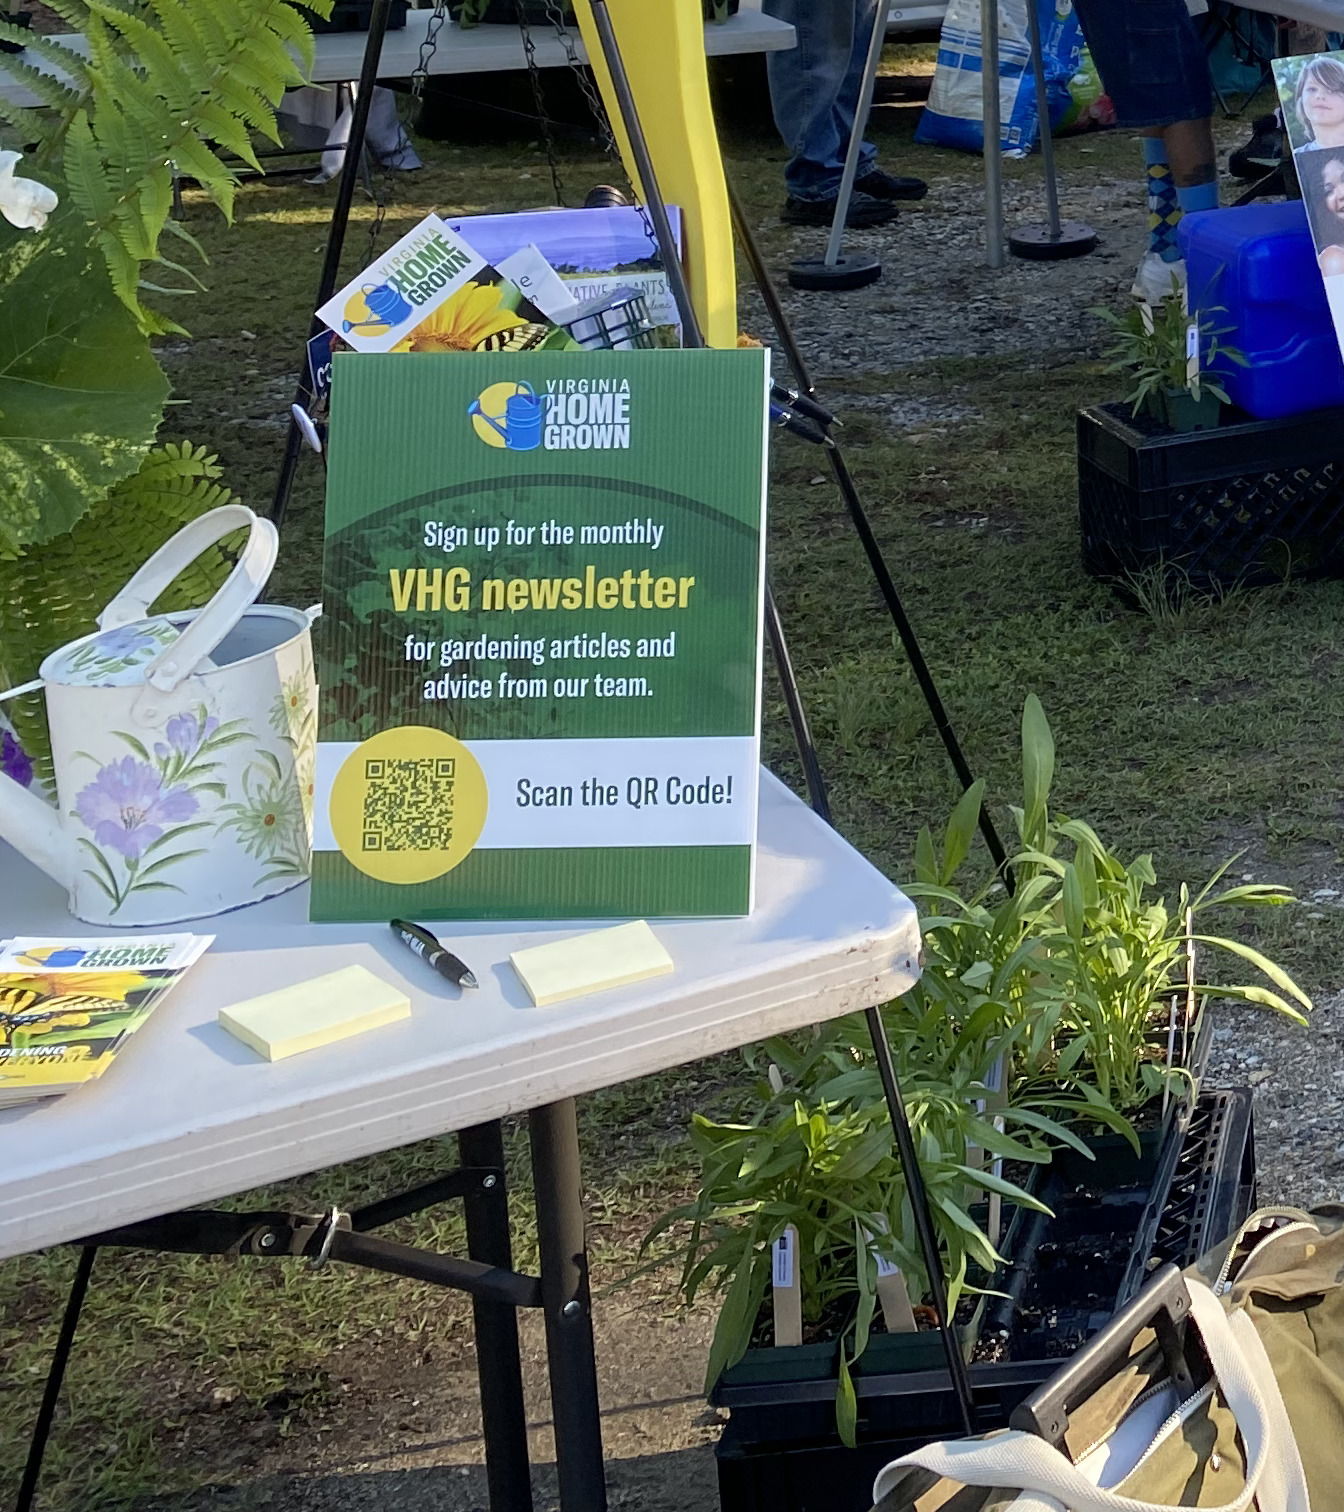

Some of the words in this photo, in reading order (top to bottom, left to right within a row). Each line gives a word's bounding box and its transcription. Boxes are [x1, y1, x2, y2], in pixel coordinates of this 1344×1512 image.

[378, 227, 439, 276] VIRGINIA
[393, 233, 459, 294] HOME
[406, 248, 472, 307] GROWN
[545, 378, 631, 393] VIRGINIA
[548, 393, 631, 424] HOME
[544, 424, 631, 450] GROWN
[423, 521, 468, 553] Sign
[475, 526, 500, 551] up
[505, 519, 536, 545] for
[540, 519, 574, 545] the
[580, 518, 664, 550] monthly
[389, 567, 471, 611] VHG
[482, 565, 696, 611] newsletter
[404, 634, 436, 661] for
[439, 634, 546, 667] gardening
[550, 632, 631, 659] articles
[636, 631, 676, 659] and
[423, 673, 492, 699] advice
[498, 672, 548, 699] from
[553, 678, 589, 698] our
[594, 673, 654, 698] team.
[516, 778, 573, 807] Scan
[581, 777, 618, 806] the
[626, 777, 659, 809] QR
[666, 775, 733, 805] Code!
[80, 955, 168, 967] GROWN
[88, 947, 172, 960] HOME
